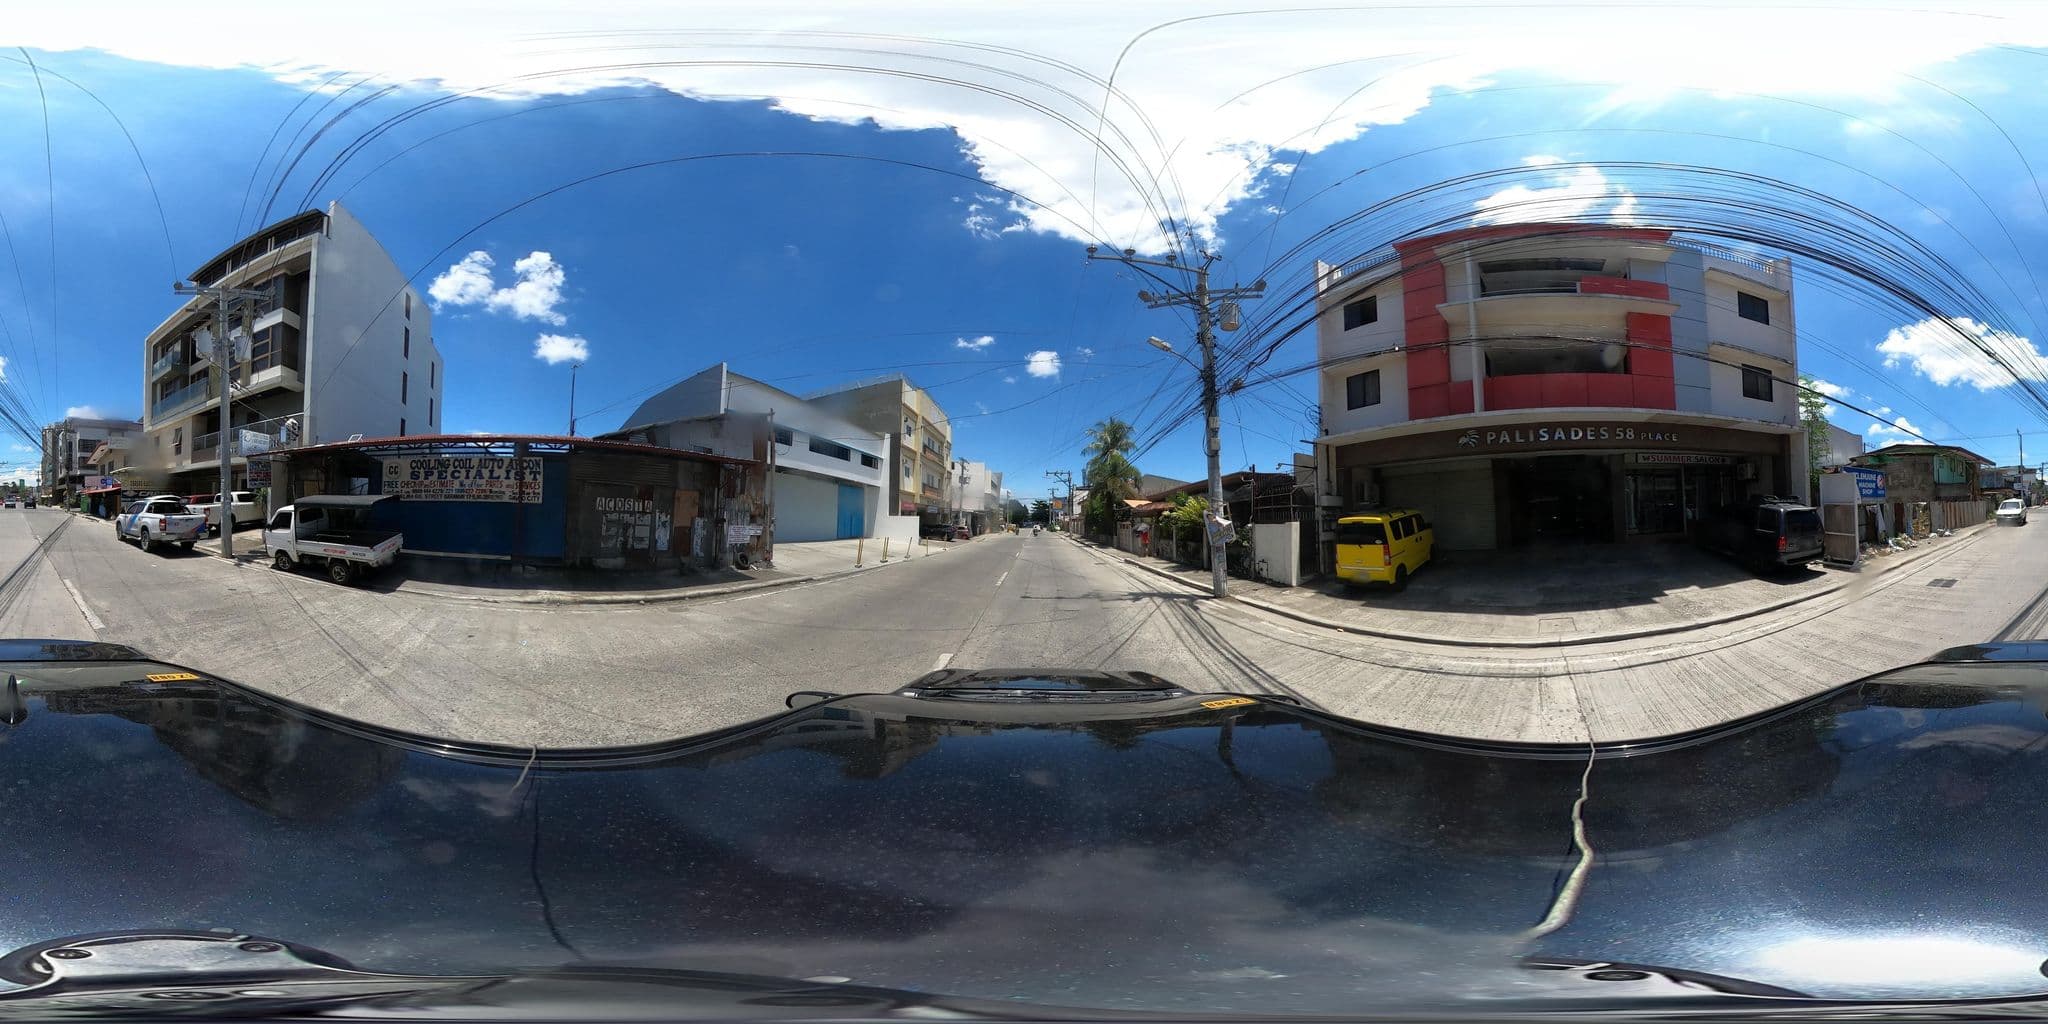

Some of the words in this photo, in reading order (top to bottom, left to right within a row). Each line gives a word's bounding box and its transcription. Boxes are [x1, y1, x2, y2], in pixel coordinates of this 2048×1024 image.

[1487, 427, 1609, 444] PALISADES
[1616, 427, 1635, 440] 58
[1641, 432, 1679, 441] PLACE
[410, 459, 451, 471] COOLING
[453, 459, 475, 470] COIL
[477, 459, 504, 470] AUTO
[1651, 455, 1691, 464] SUMMER
[410, 470, 541, 481] SPECIALIST
[383, 480, 399, 489] FREE
[485, 480, 504, 488] PARTS
[597, 497, 653, 512] ACOSTA
